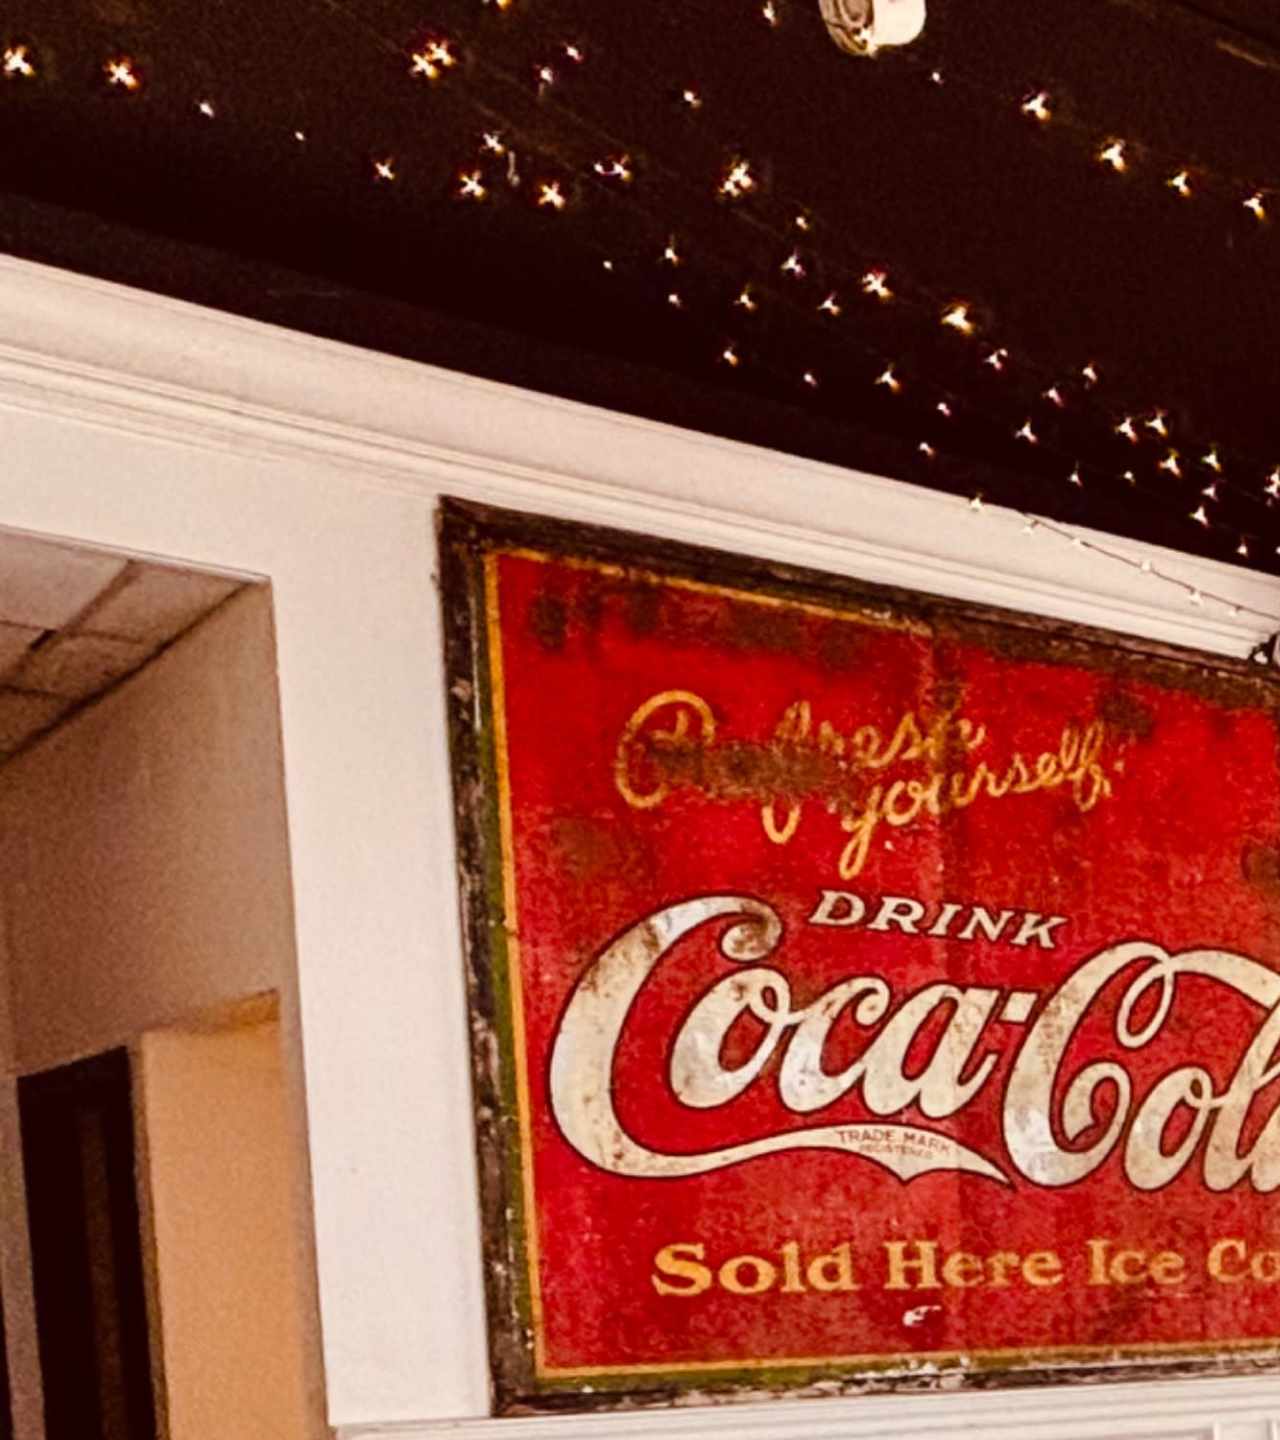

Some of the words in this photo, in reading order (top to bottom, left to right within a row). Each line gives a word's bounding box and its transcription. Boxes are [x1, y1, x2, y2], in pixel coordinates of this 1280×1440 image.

[613, 688, 986, 845] Rfresh
[838, 722, 1113, 880] yourself
[808, 889, 1068, 950] DRINK
[836, 1129, 895, 1145] TRADE
[902, 1130, 952, 1154] MARK
[651, 1243, 858, 1297] Sold
[883, 1240, 1063, 1290] Here
[1087, 1239, 1186, 1287] Ice
